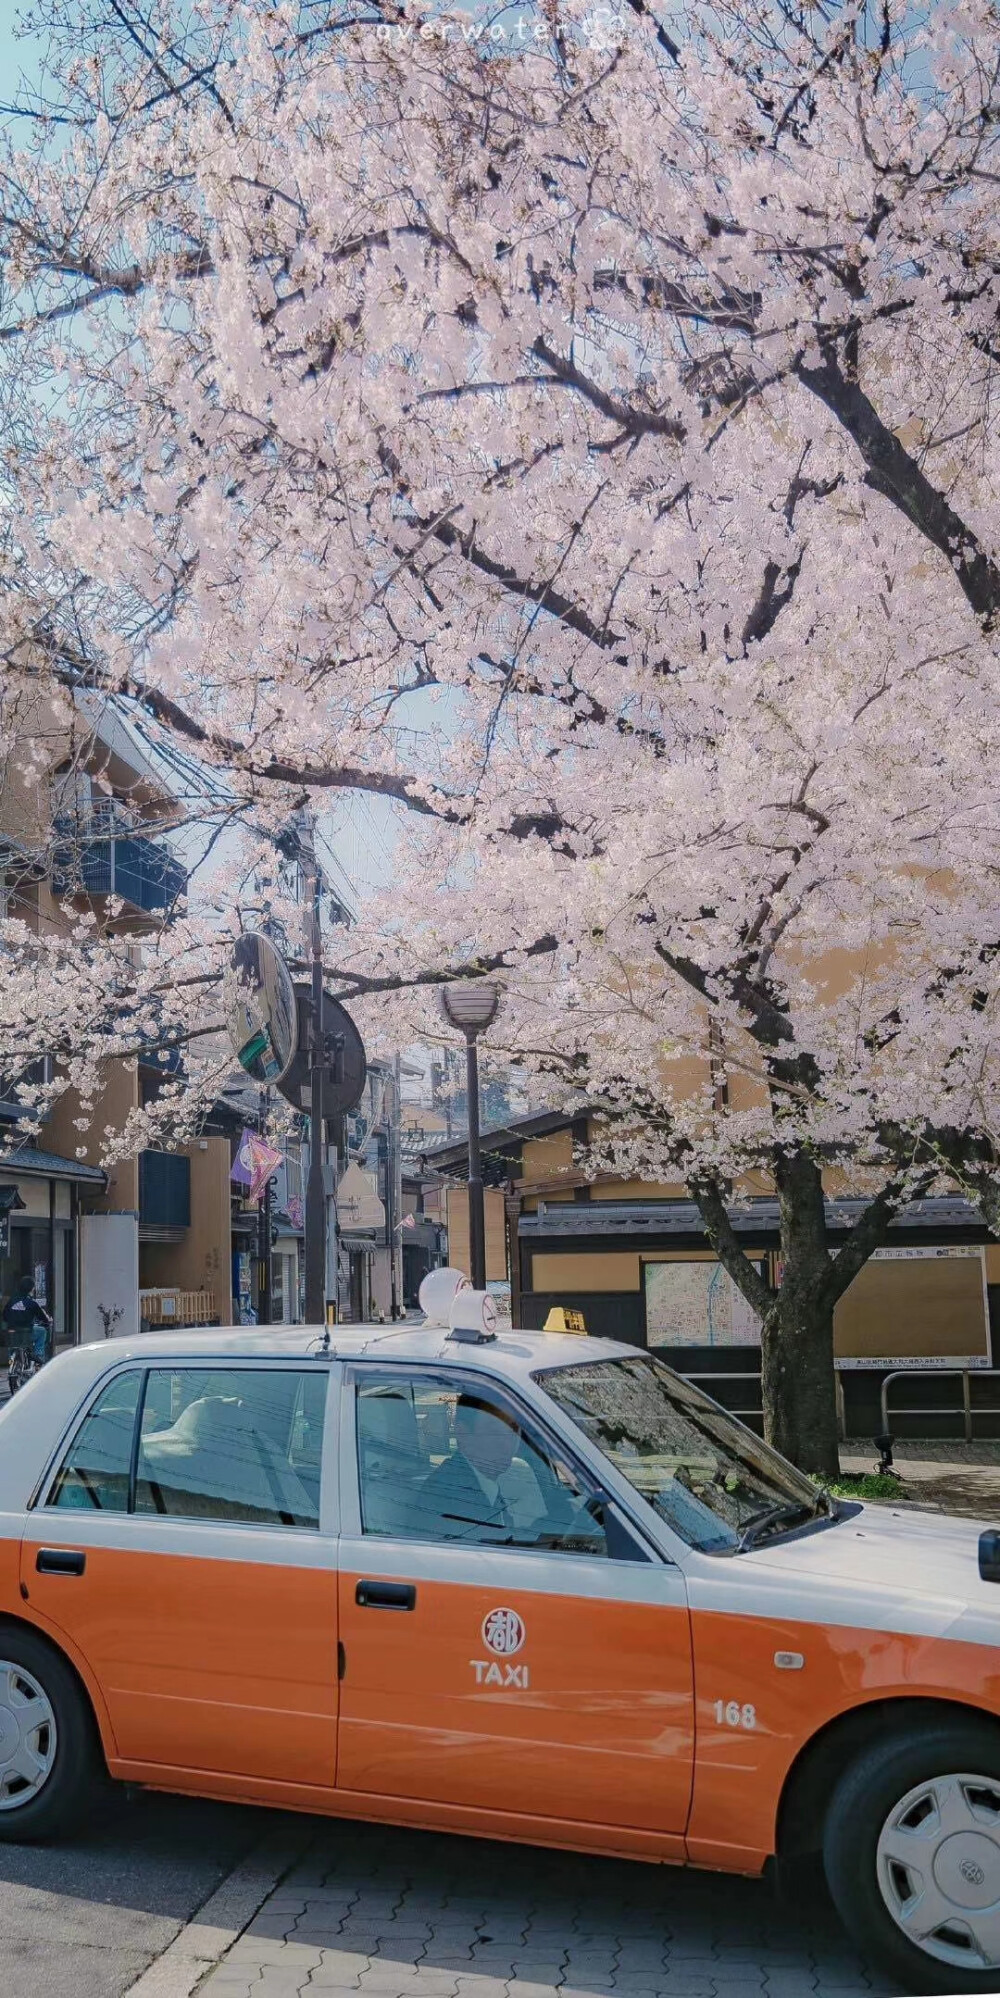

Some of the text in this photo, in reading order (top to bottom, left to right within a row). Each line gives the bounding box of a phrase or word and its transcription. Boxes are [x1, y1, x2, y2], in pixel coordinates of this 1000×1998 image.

[486, 1611, 520, 1652] 都
[469, 1660, 528, 1689] TAXI
[714, 1699, 756, 1729] 168
